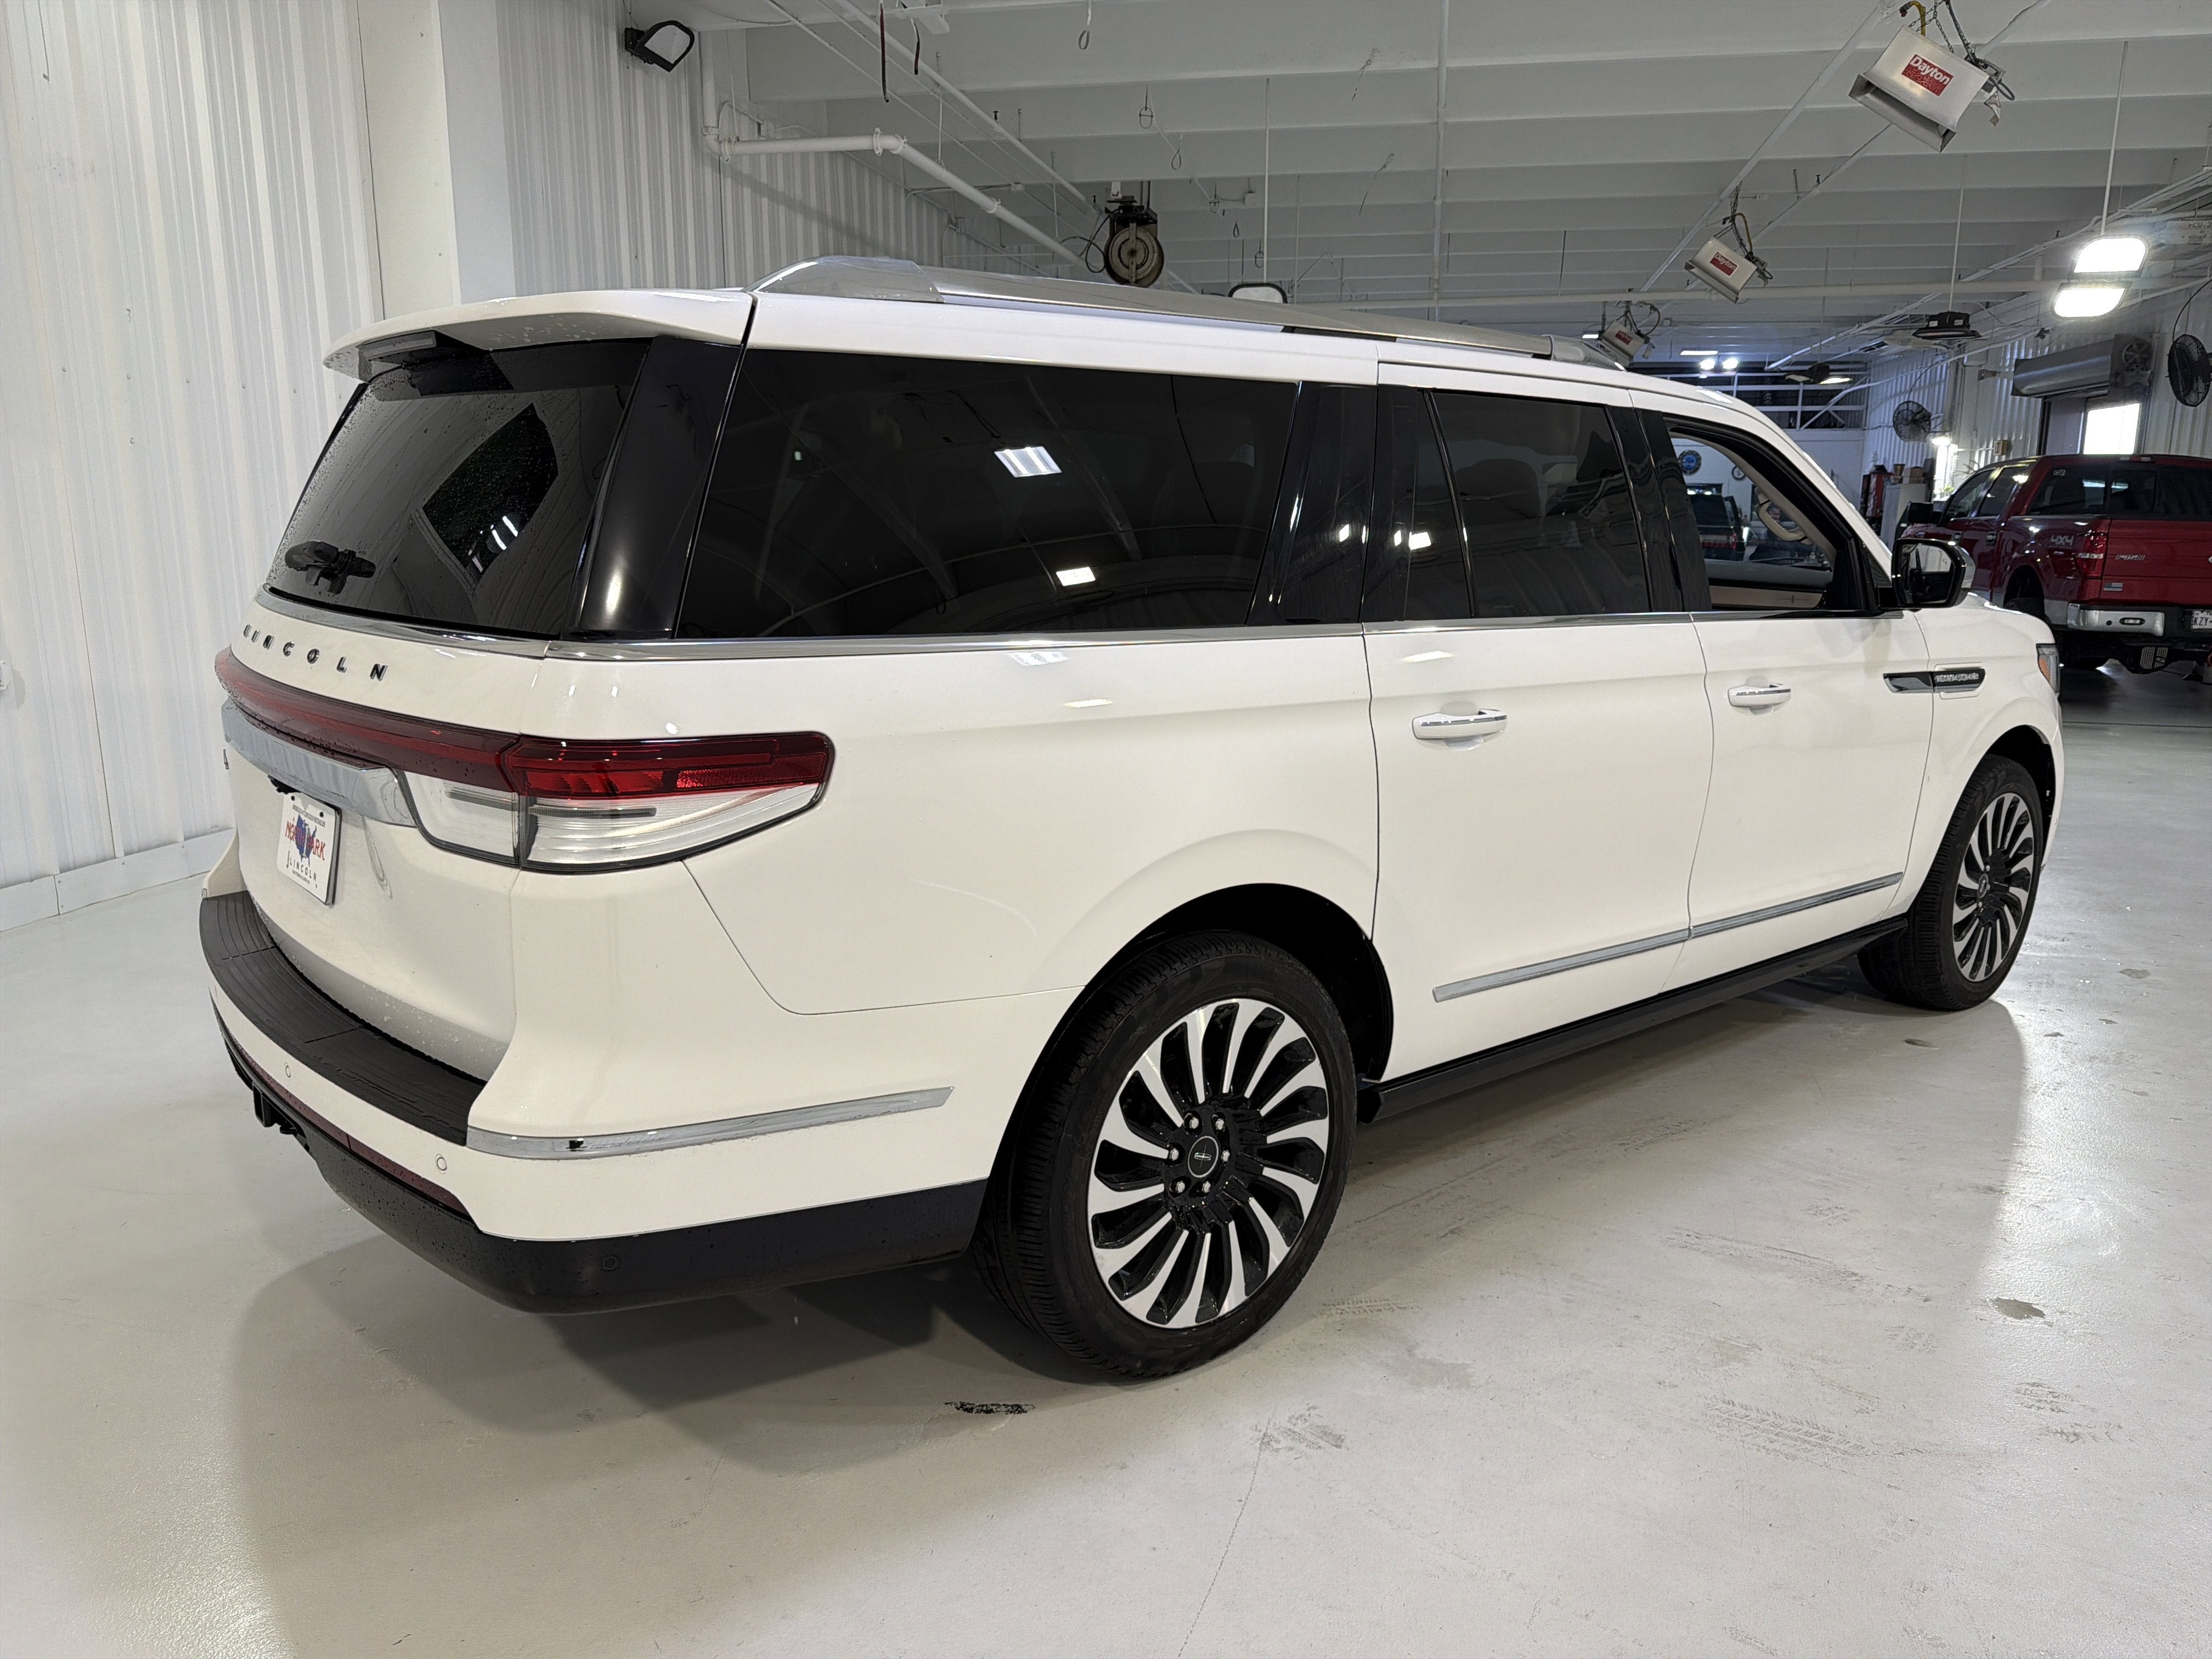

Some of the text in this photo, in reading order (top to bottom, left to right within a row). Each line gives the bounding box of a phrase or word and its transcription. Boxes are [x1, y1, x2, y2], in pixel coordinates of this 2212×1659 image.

[1910, 56, 1951, 85] Dayton
[1714, 253, 1736, 270] Dayton
[243, 624, 388, 681] LINCOLN
[308, 834, 326, 861] PARK
[290, 857, 317, 882] LINCOLN
